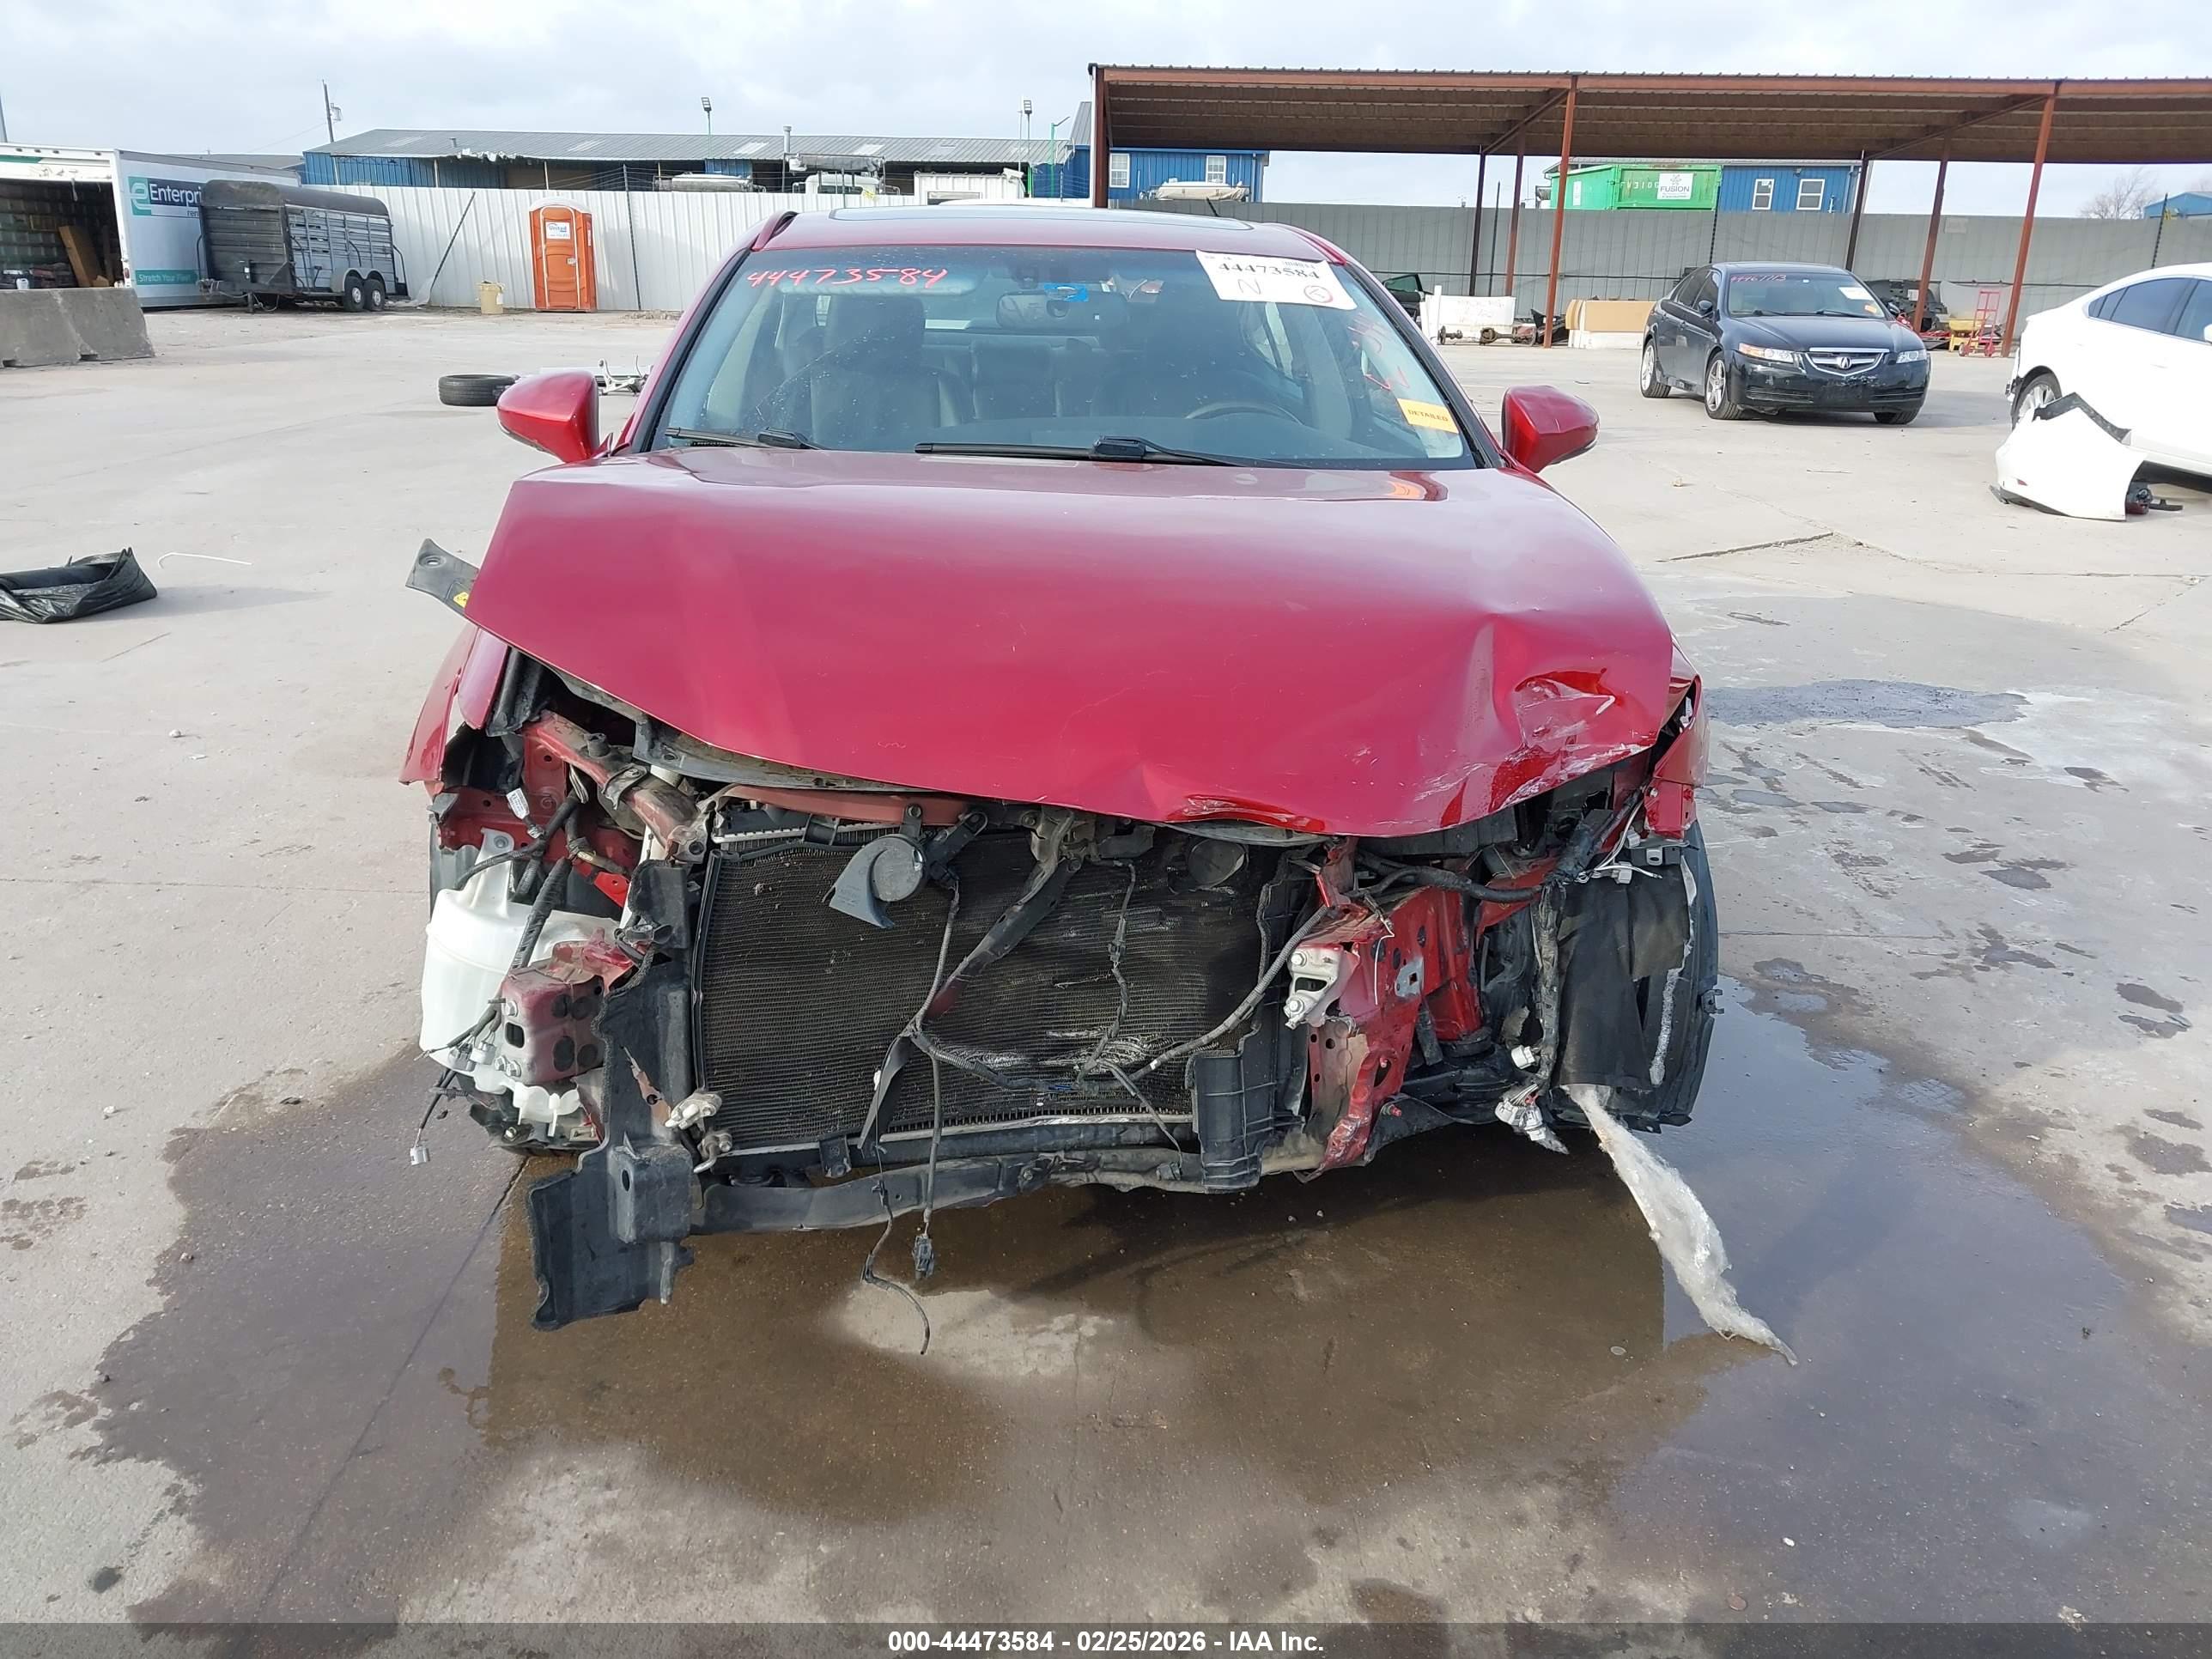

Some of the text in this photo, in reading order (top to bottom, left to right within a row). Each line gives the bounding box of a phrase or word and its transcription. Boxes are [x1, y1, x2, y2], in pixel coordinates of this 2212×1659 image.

[746, 268, 948, 289] 44473584
[1218, 263, 1321, 279] 44473584
[1407, 410, 1449, 422] DETAILED
